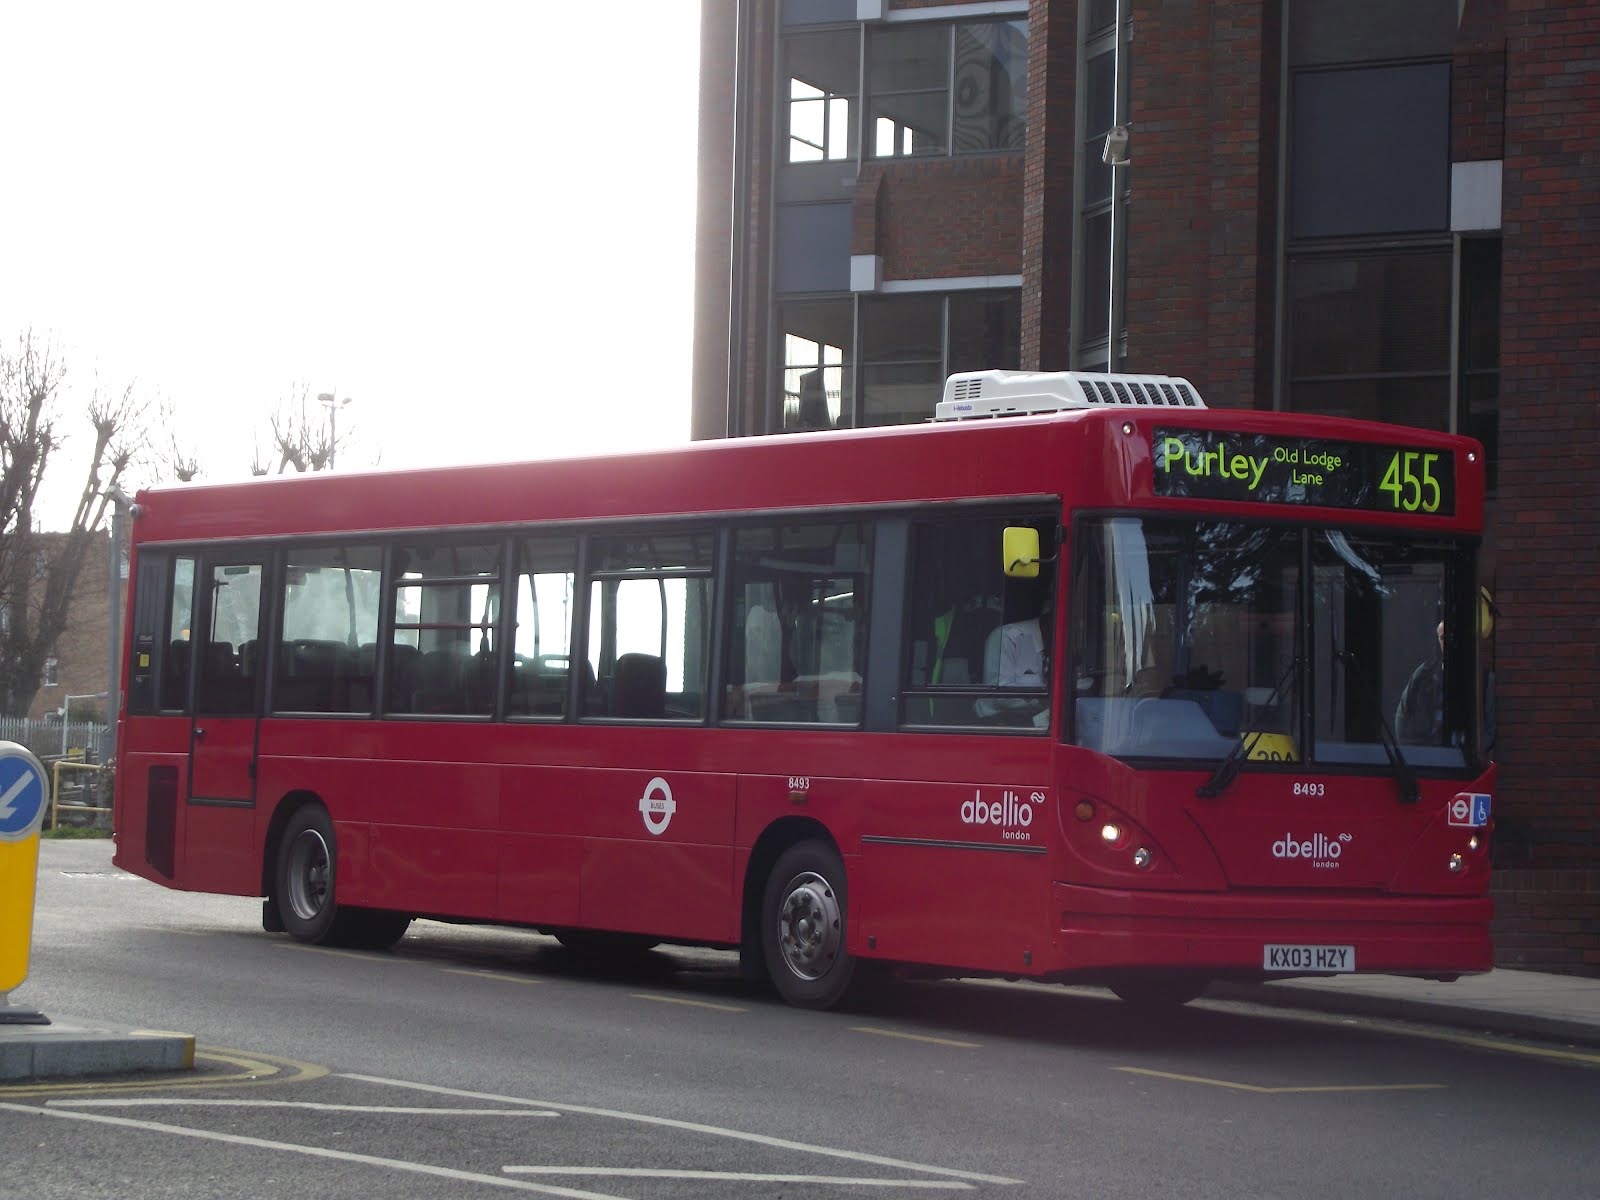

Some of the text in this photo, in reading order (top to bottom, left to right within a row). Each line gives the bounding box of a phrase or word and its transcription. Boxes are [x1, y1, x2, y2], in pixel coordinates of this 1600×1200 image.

[1164, 437, 1269, 490] Purley
[1274, 447, 1342, 471] Old Lodge
[1293, 472, 1323, 486] Lane
[1379, 450, 1441, 513] 455
[788, 777, 810, 790] 8493
[1293, 782, 1325, 797] 8493
[650, 801, 665, 811] BUSES
[960, 789, 1033, 827] abellio
[1002, 829, 1031, 841] london
[1272, 832, 1342, 859] abellio
[1312, 860, 1340, 869] london
[1270, 947, 1347, 969] KX03 HZY
